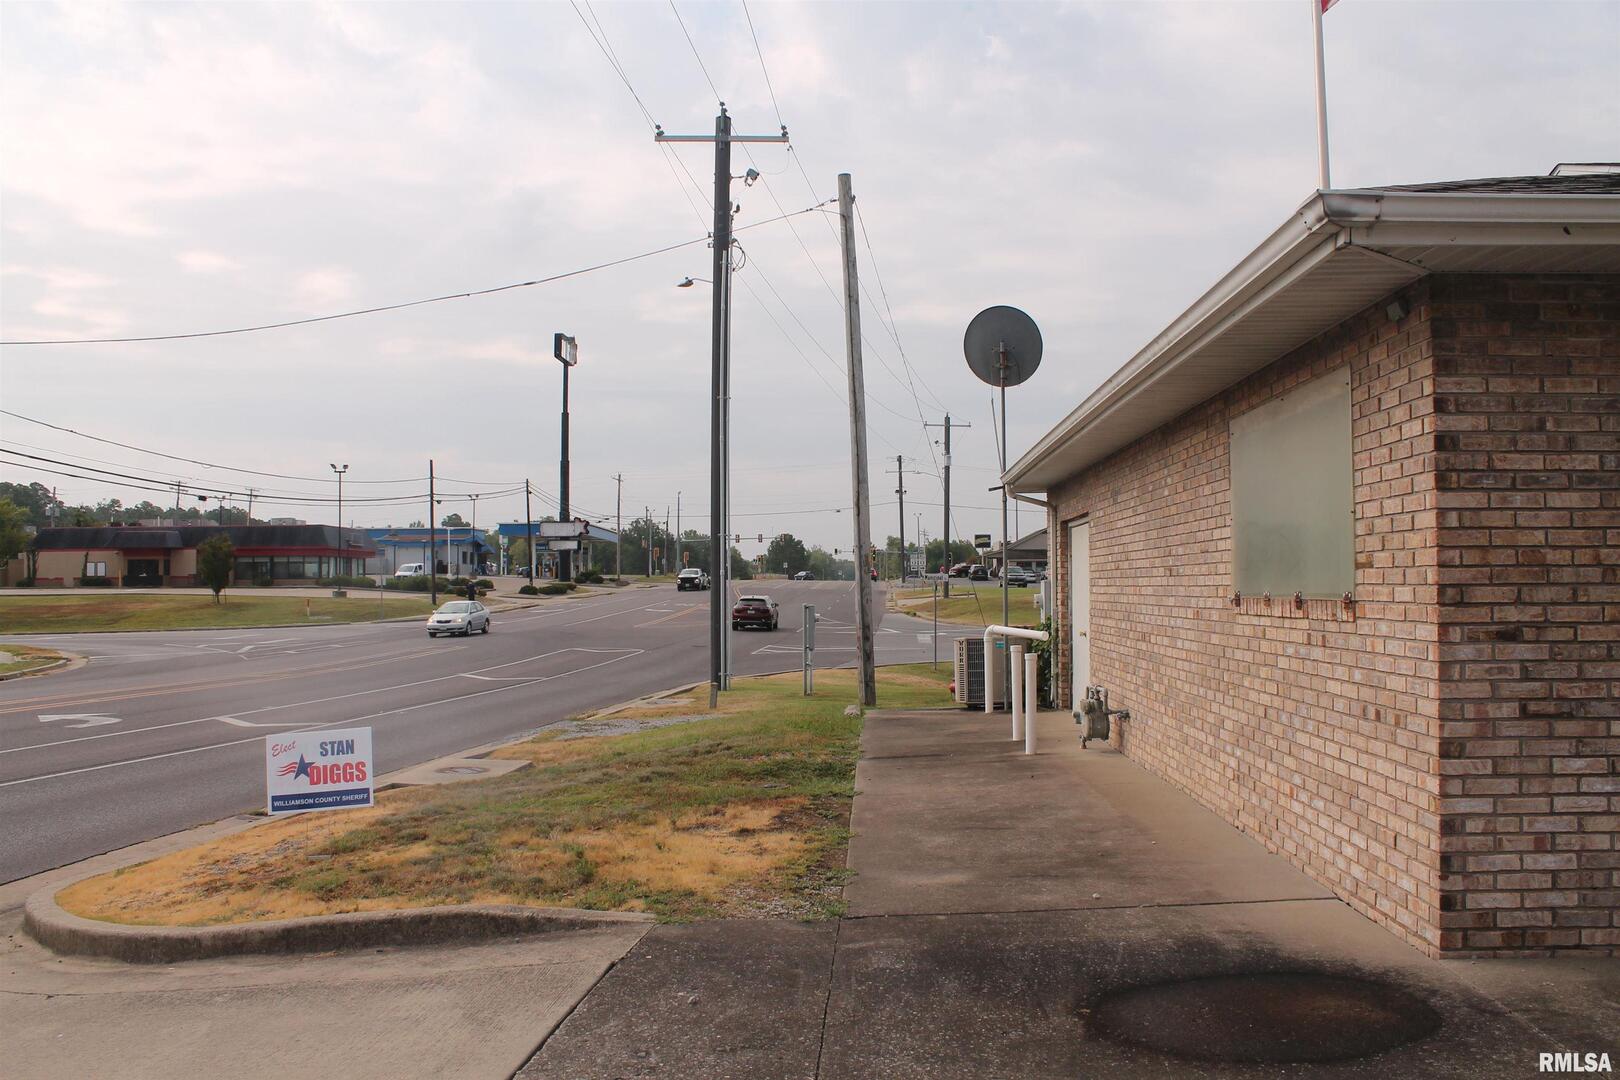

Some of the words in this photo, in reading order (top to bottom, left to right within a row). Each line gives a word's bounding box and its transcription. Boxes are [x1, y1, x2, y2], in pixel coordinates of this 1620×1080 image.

[272, 740, 296, 757] Elect
[320, 739, 354, 756] STAN
[309, 761, 367, 785] DIGGS
[273, 798, 313, 807] WILLIAMSON
[342, 793, 368, 801] SHERIFF
